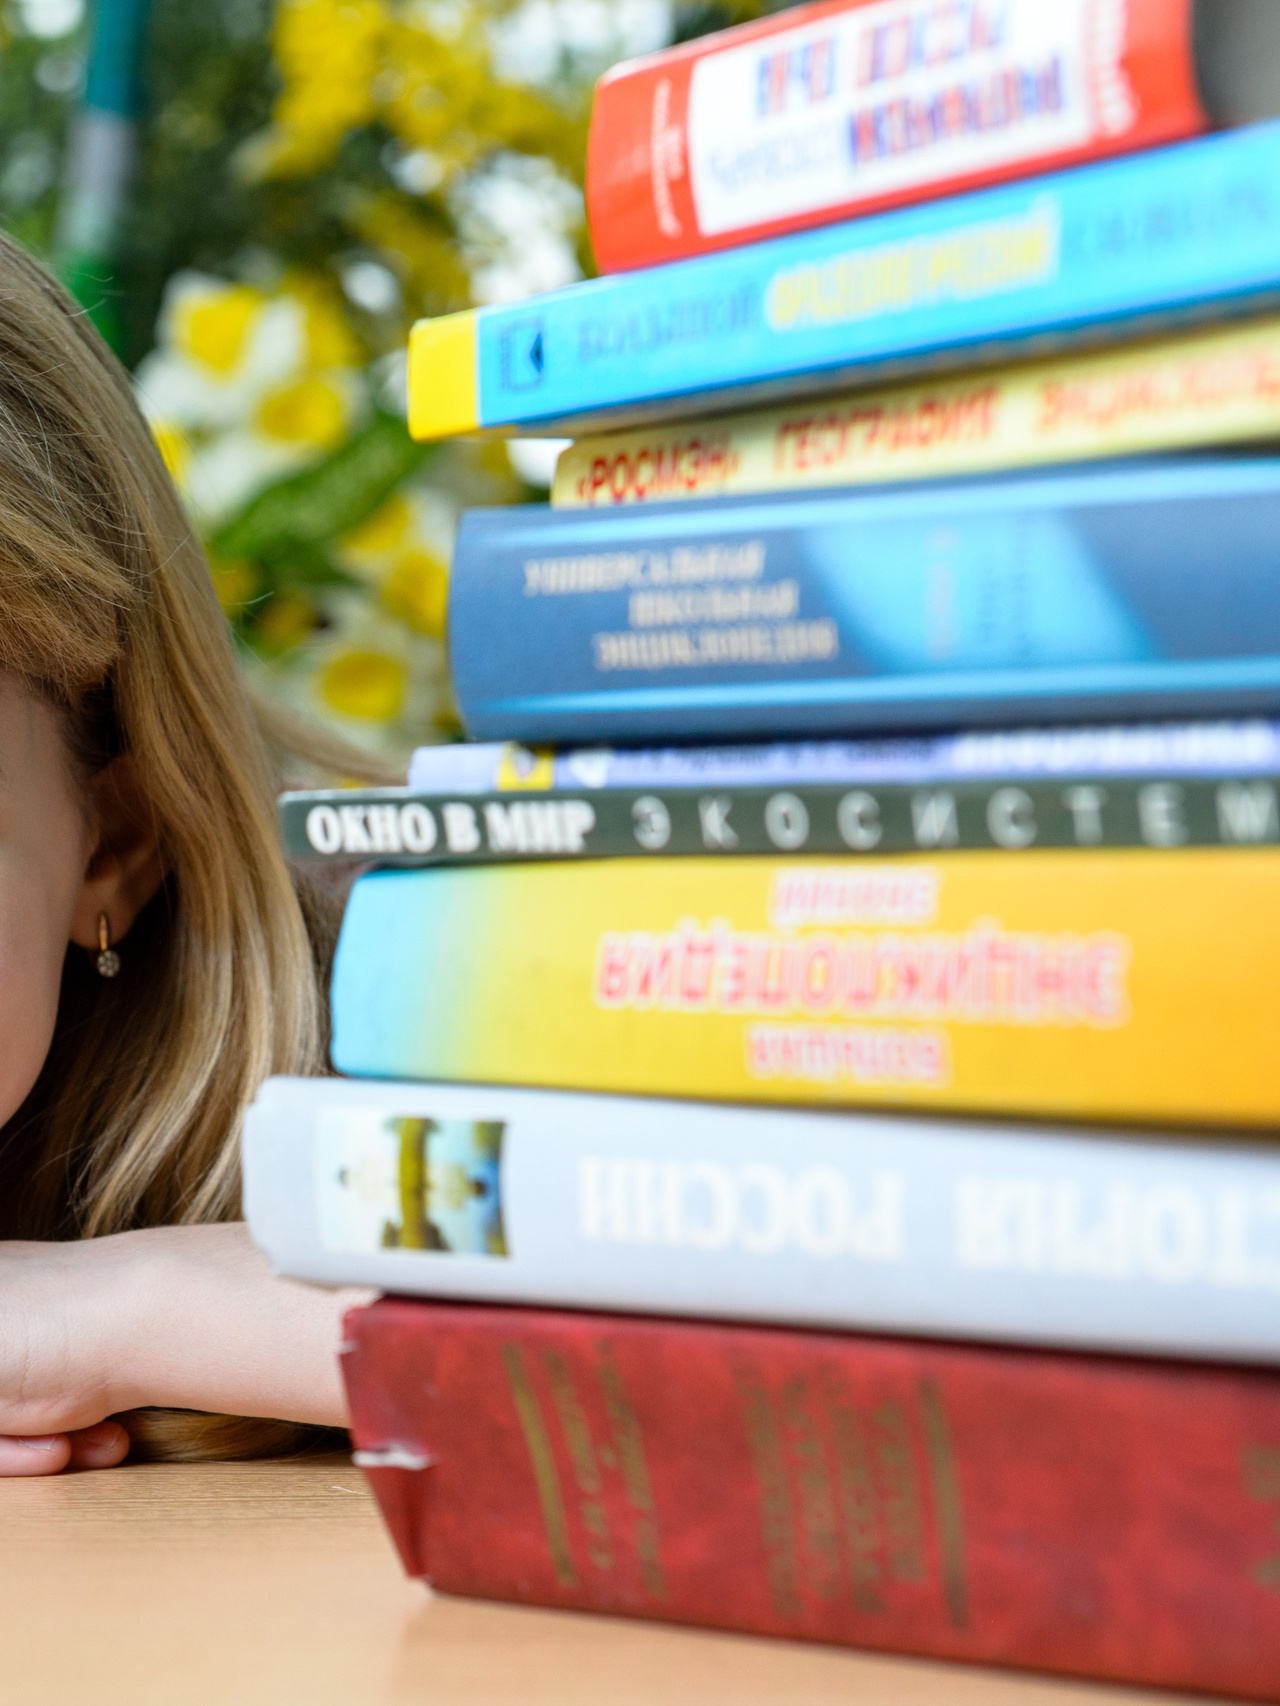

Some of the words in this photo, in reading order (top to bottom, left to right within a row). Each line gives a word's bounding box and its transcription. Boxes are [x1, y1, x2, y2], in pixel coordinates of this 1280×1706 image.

[774, 385, 996, 476] ГЕОГРАФИЯ
[306, 801, 437, 854] ОКНО
[441, 801, 480, 853] В
[483, 799, 596, 853] МИР
[596, 920, 1130, 1027] ЭНЦИКЛОПЕДИЯ
[577, 1156, 908, 1263] РОССИИ
[954, 1172, 1280, 1291] ТОРИЯ
